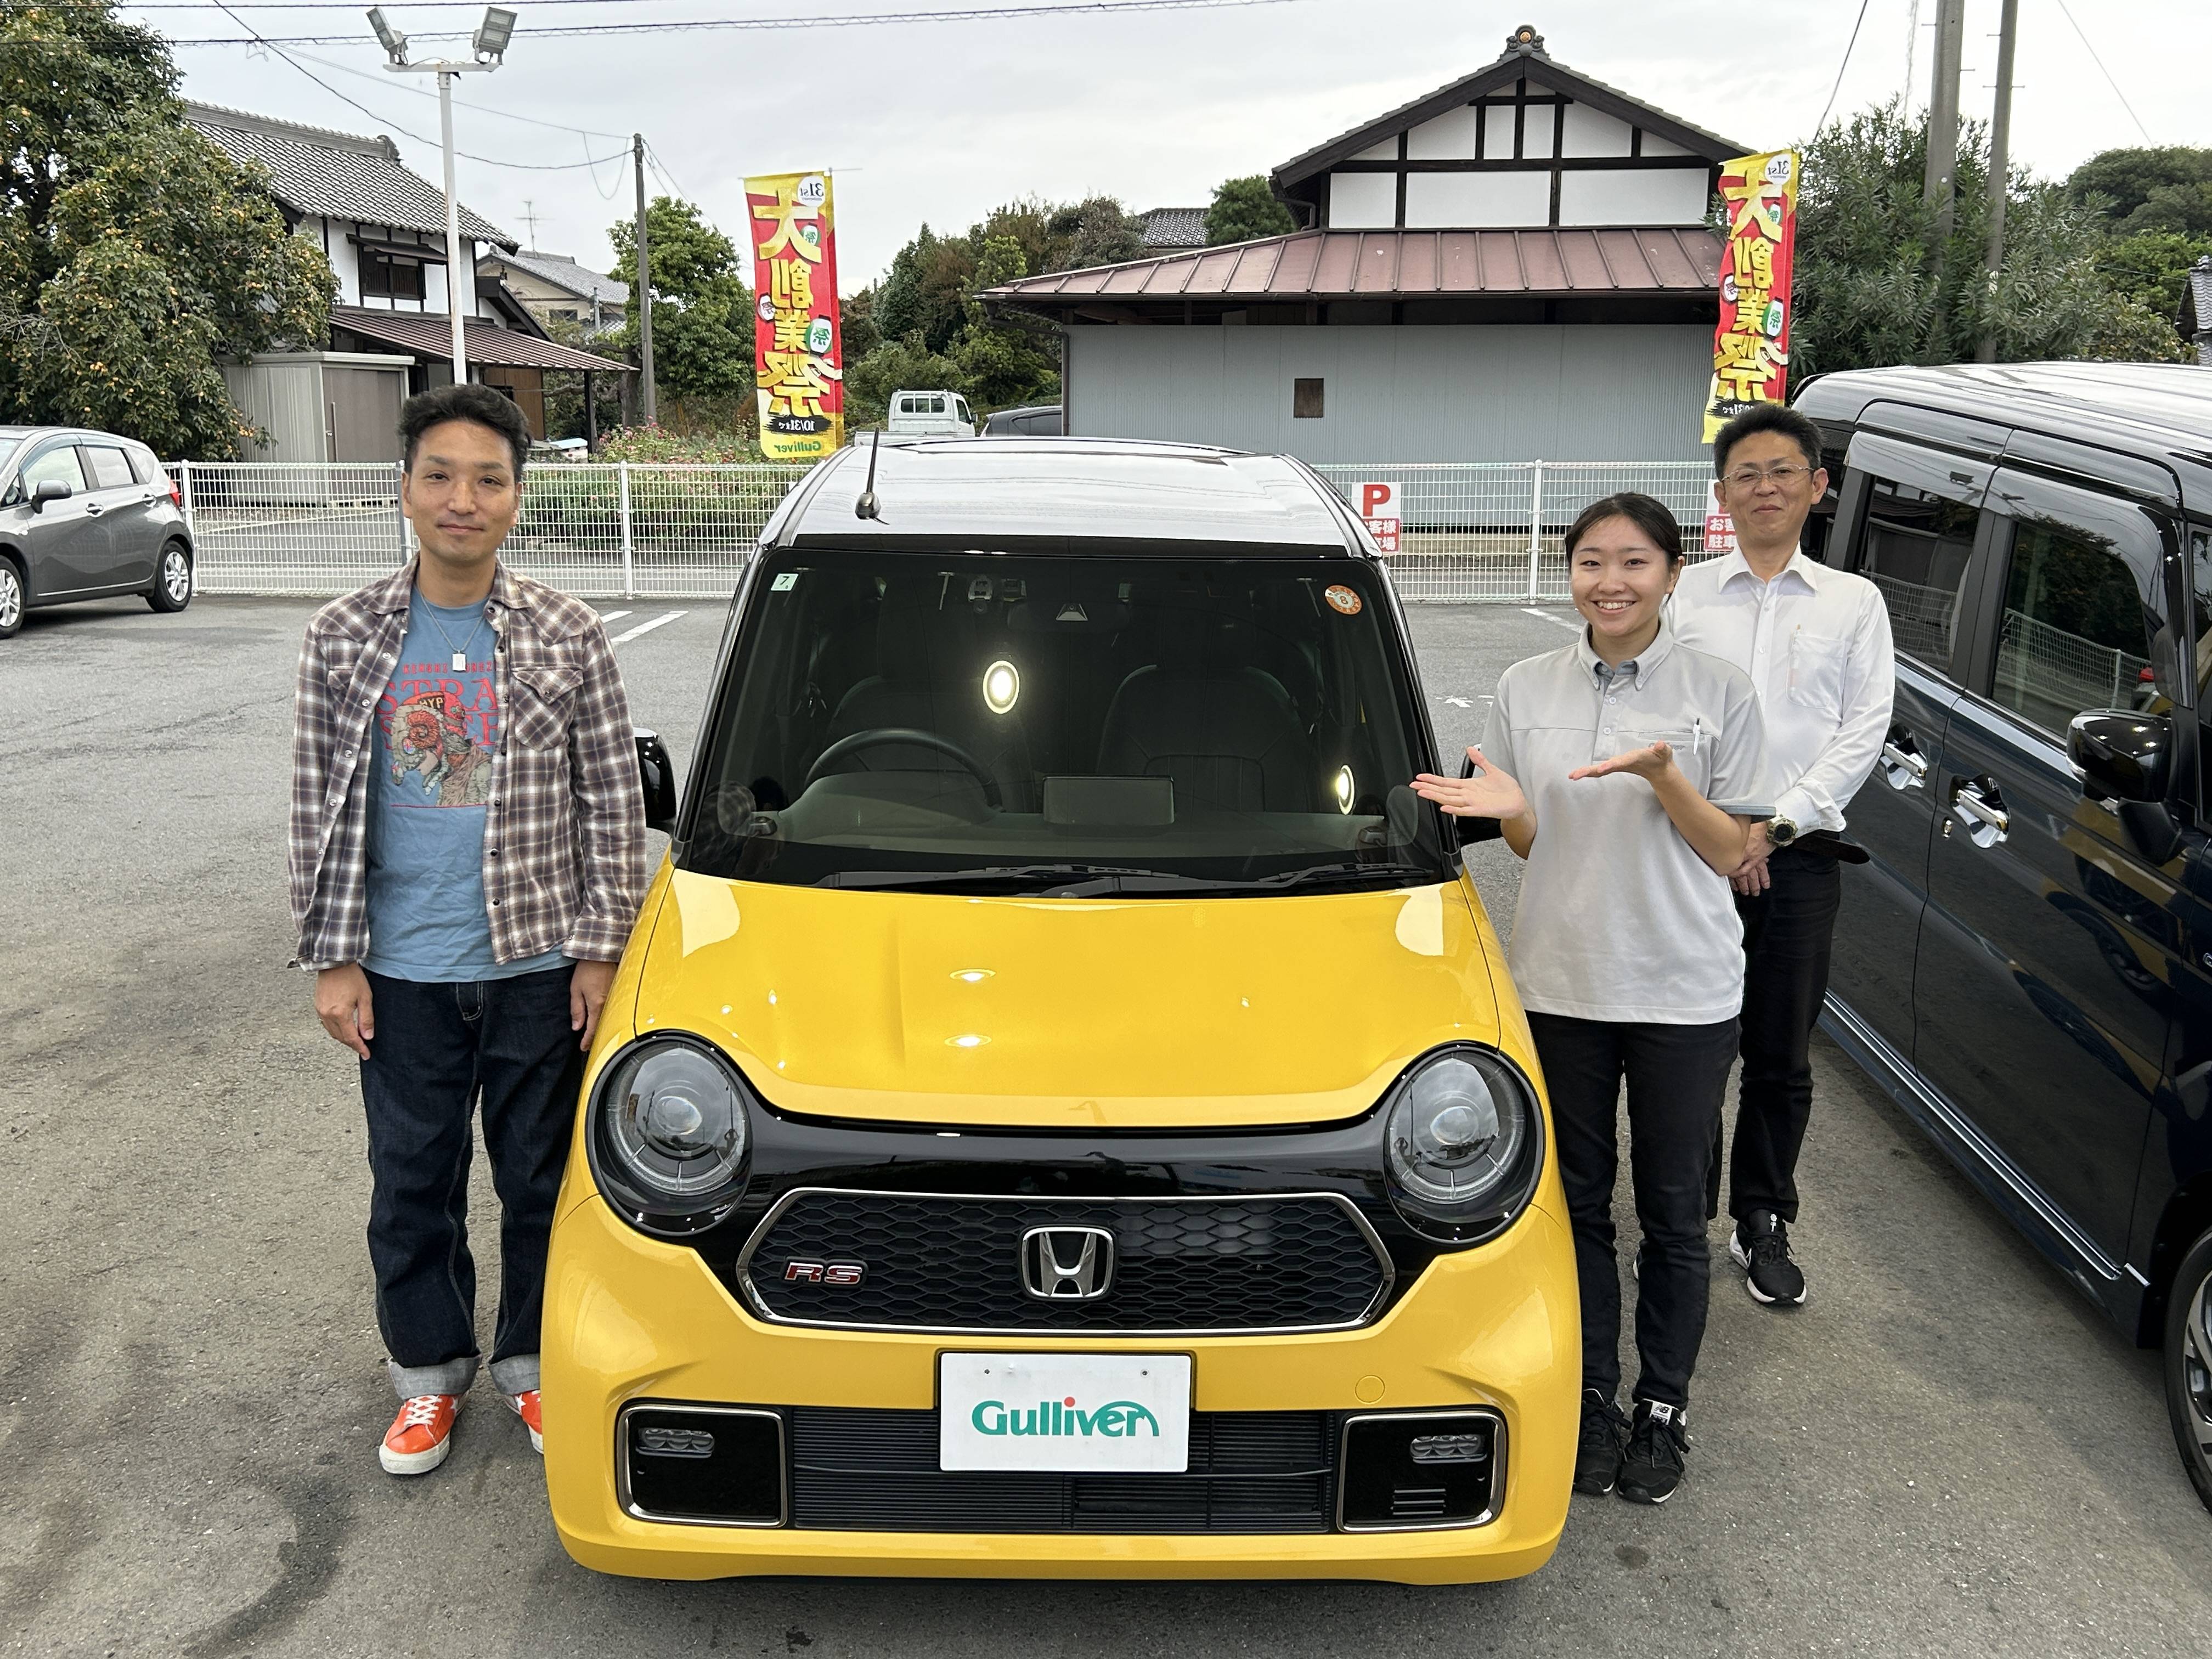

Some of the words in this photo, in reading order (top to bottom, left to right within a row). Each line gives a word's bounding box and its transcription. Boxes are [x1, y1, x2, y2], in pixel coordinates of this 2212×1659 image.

[1363, 484, 1391, 517] P
[1365, 519, 1396, 534] 客様
[780, 575, 790, 585] 7
[784, 1261, 863, 1285] RS
[972, 1396, 1160, 1437] Gulliver
